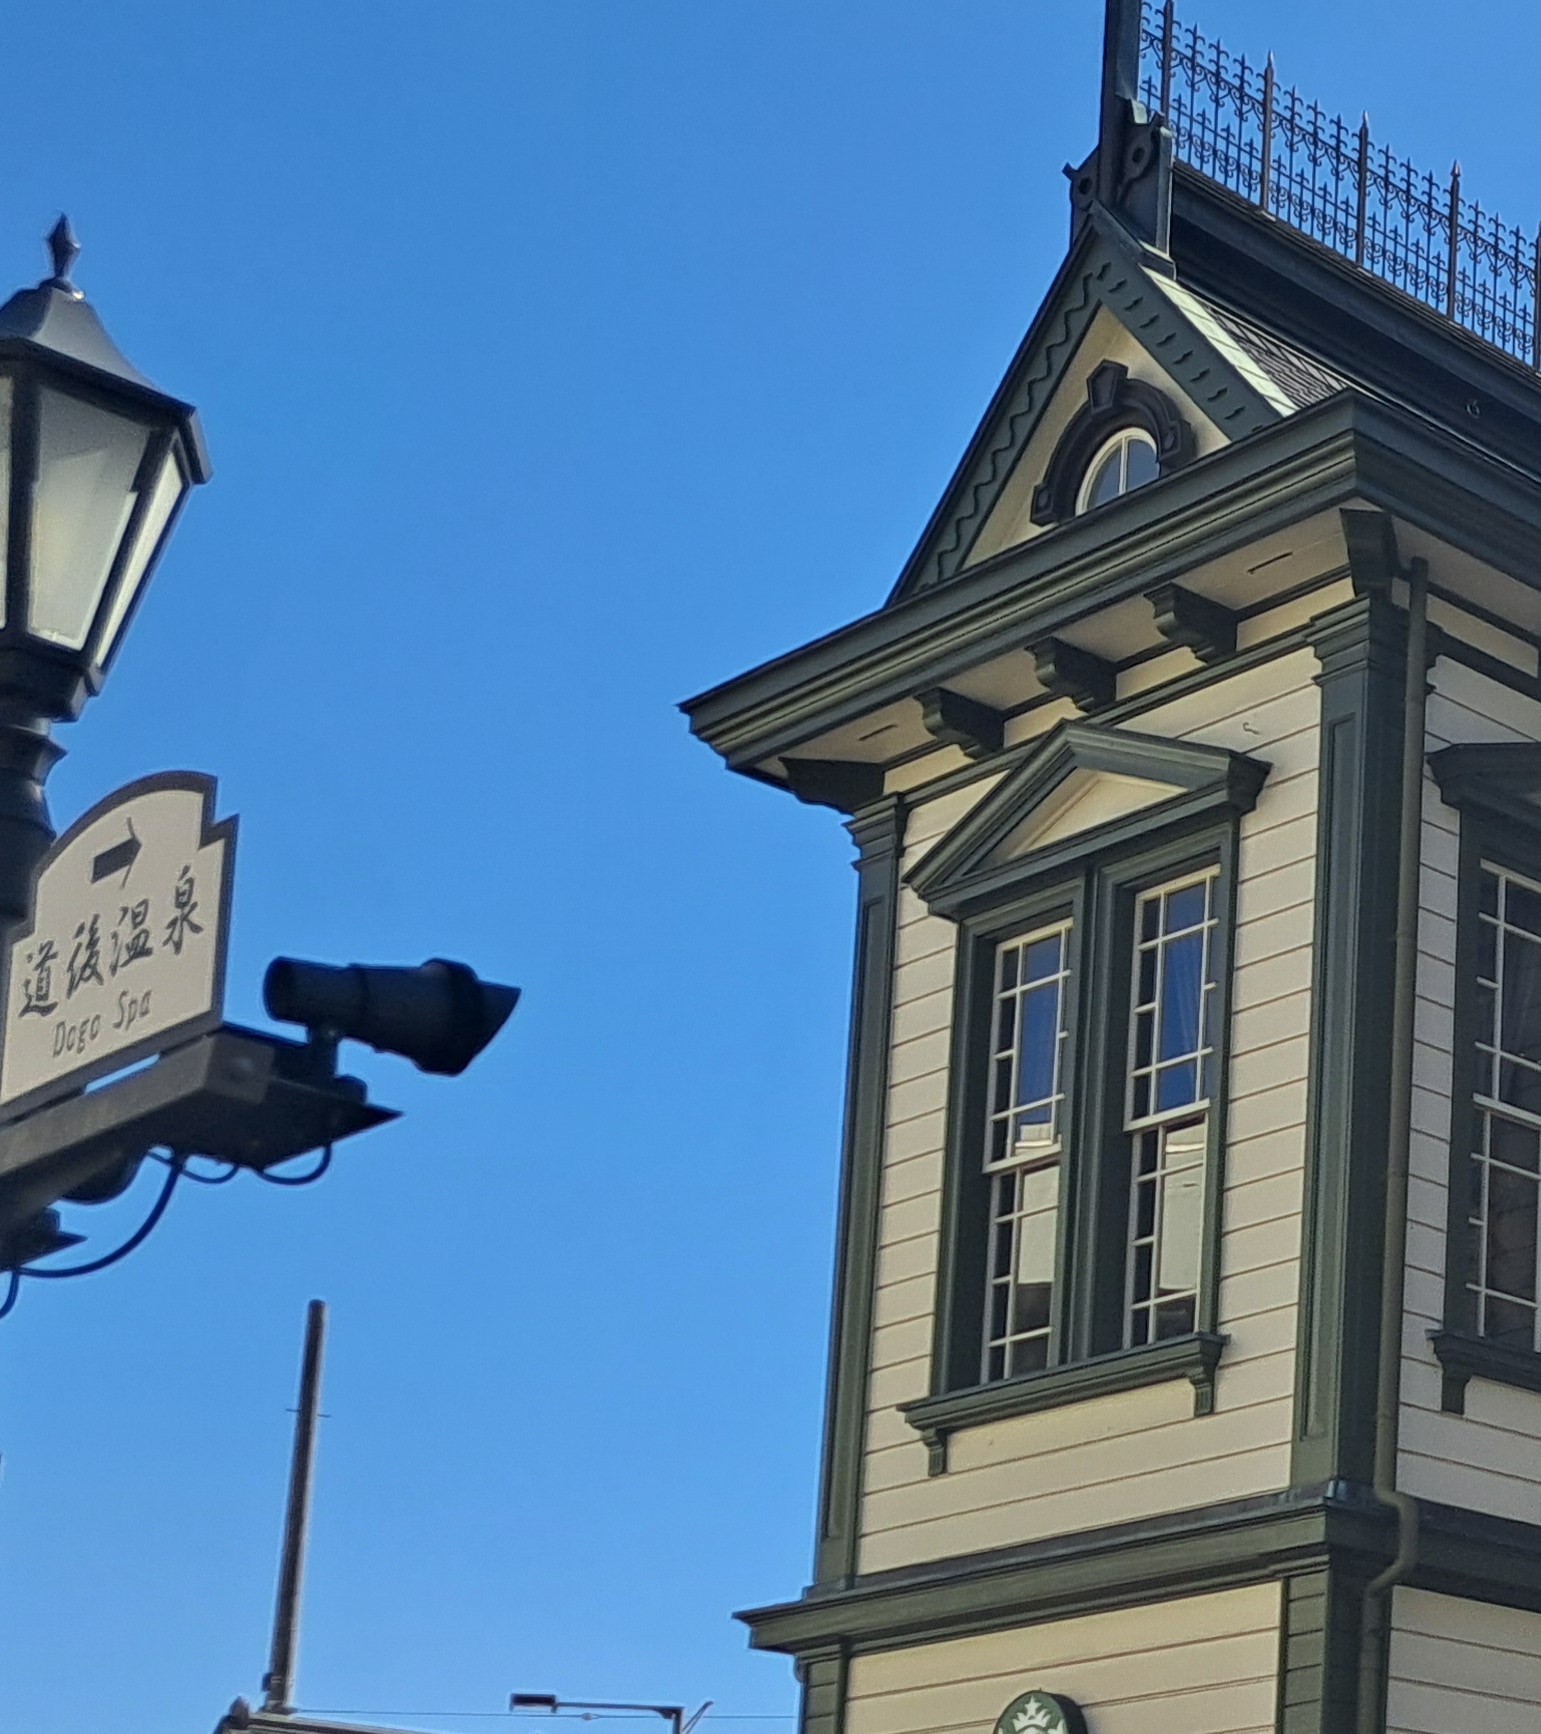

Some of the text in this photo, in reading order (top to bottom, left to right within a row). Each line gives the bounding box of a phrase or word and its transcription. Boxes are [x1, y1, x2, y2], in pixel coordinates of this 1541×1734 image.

[19, 865, 203, 1018] 道後温泉
[53, 990, 152, 1058] Dogo Spa
